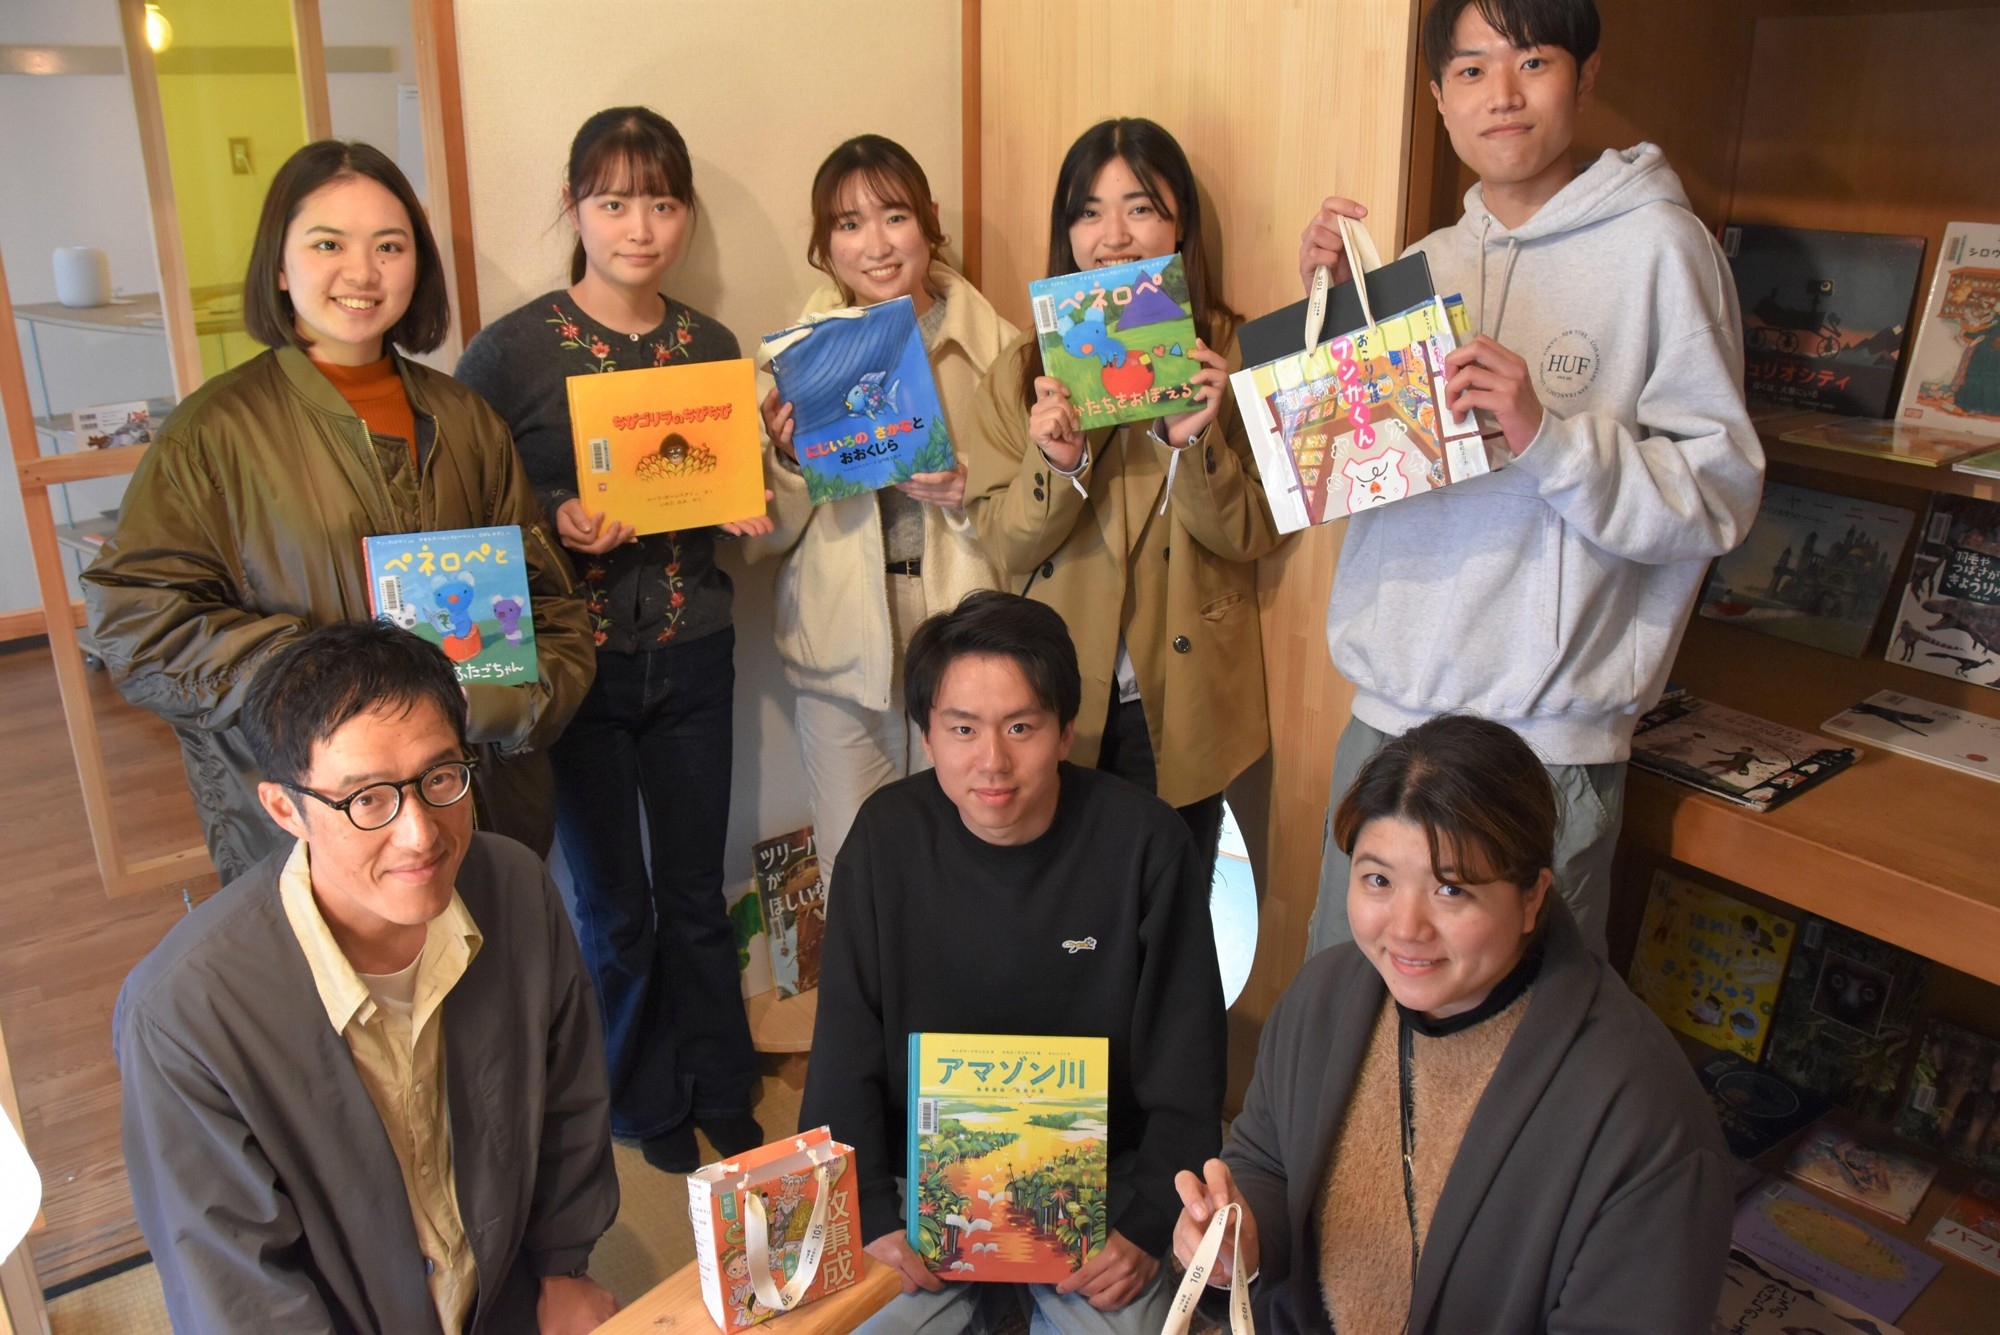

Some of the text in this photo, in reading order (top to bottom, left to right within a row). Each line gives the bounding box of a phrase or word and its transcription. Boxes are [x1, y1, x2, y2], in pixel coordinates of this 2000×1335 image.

[1058, 272, 1163, 312] ペネロペ
[1356, 333, 1380, 404] おこりんぼ
[1547, 354, 1591, 375] HUF
[1331, 338, 1376, 449] フンガくん
[612, 402, 733, 431] ちびゴリラのちびちび
[804, 416, 925, 460] にじいろの さかなと
[839, 438, 899, 465] おおくじら
[384, 543, 509, 576] ペネロペと
[1954, 550, 1991, 567] 羽毛や
[766, 871, 785, 891] が
[937, 1055, 1086, 1089] アマゾン川
[812, 1223, 824, 1241] 105
[1190, 1264, 1205, 1284] 105
